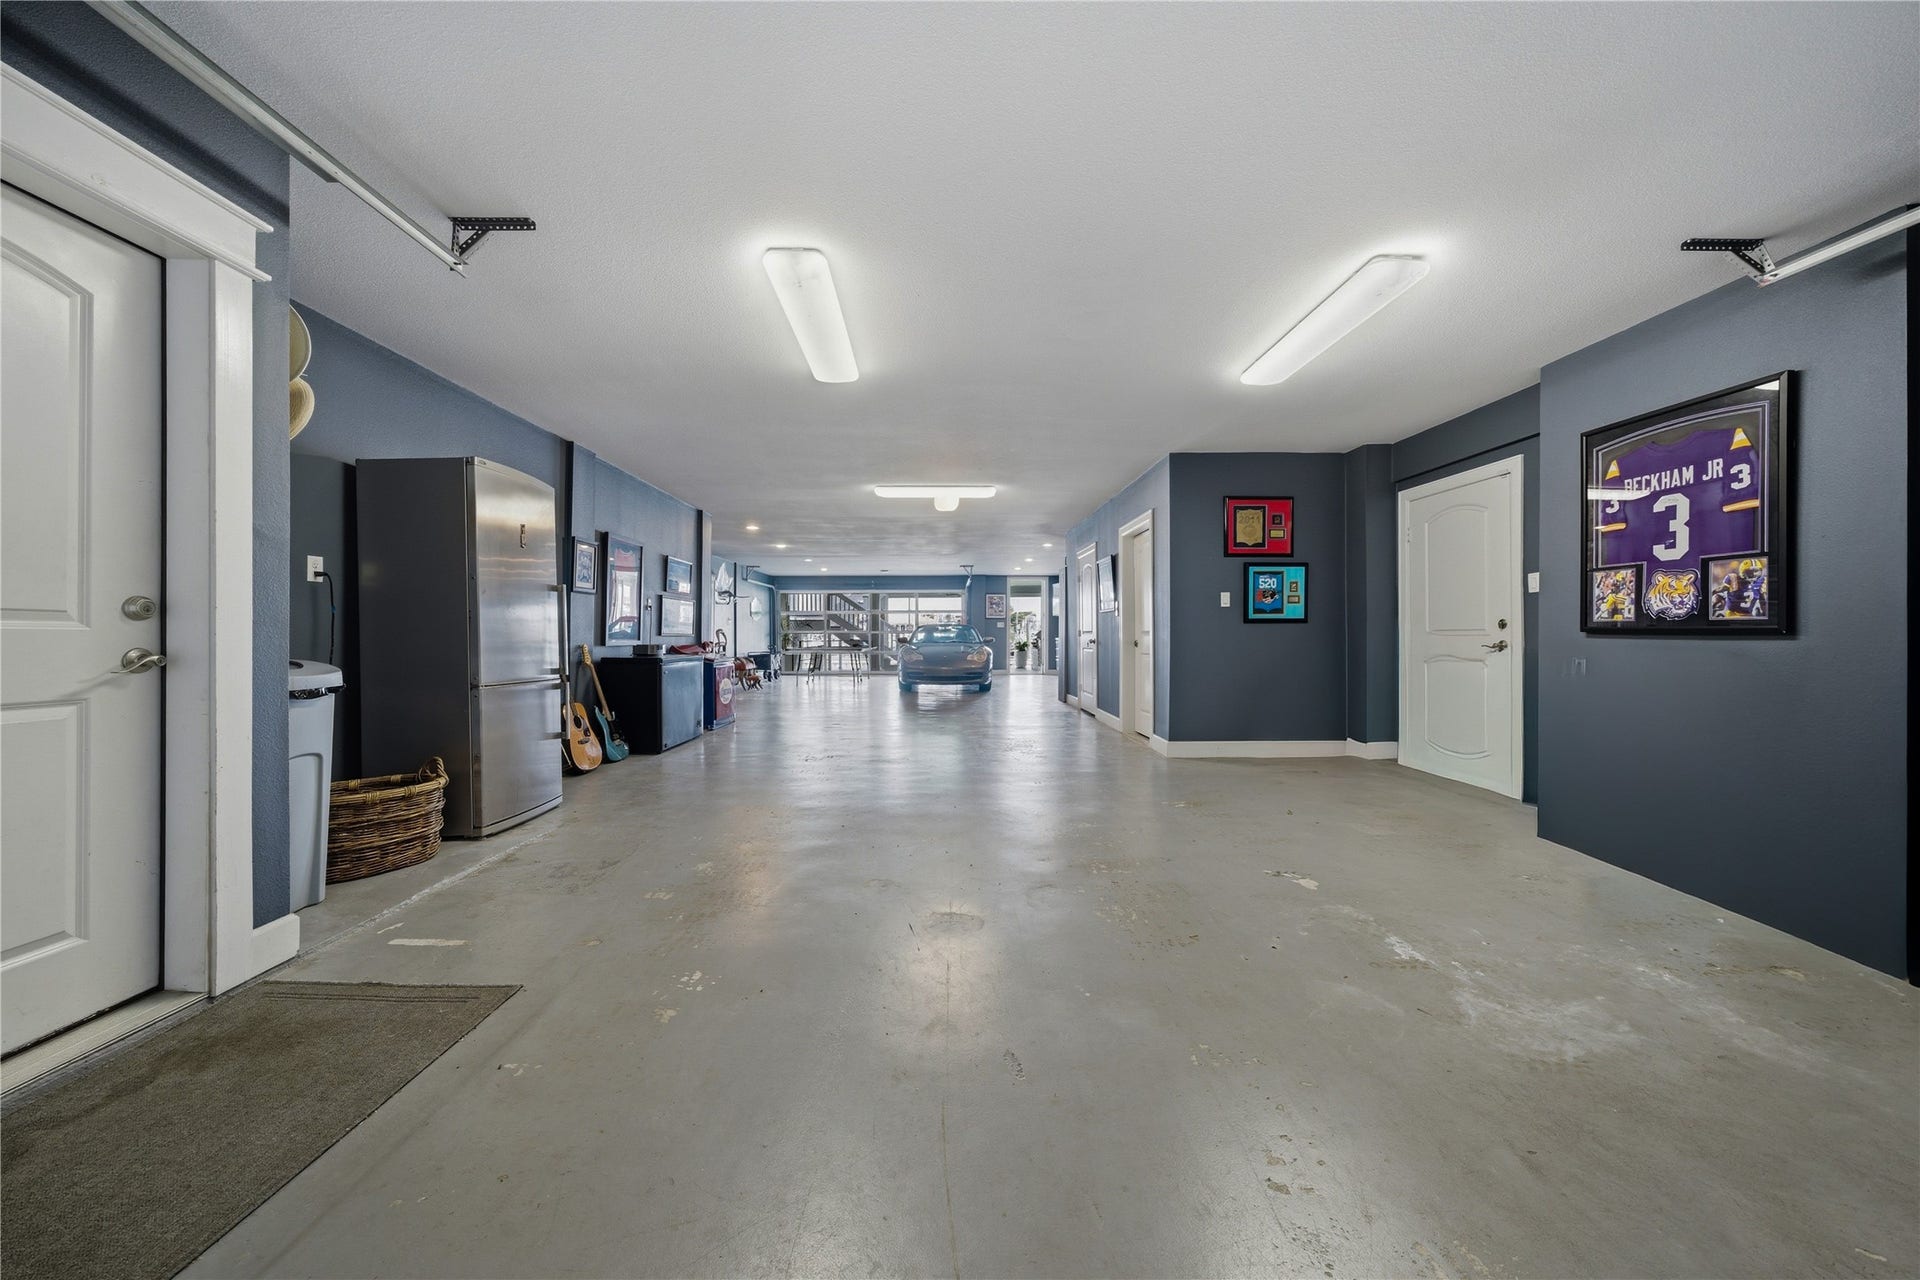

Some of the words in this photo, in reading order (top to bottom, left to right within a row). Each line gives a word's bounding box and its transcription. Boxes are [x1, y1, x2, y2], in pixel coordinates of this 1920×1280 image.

[1624, 464, 1694, 494] BECKHAM
[1703, 458, 1723, 481] JR
[1730, 463, 1751, 490] 3
[1605, 497, 1620, 514] 3
[1652, 492, 1690, 562] 3
[1259, 578, 1277, 588] 520
[1740, 591, 1754, 608] 3
